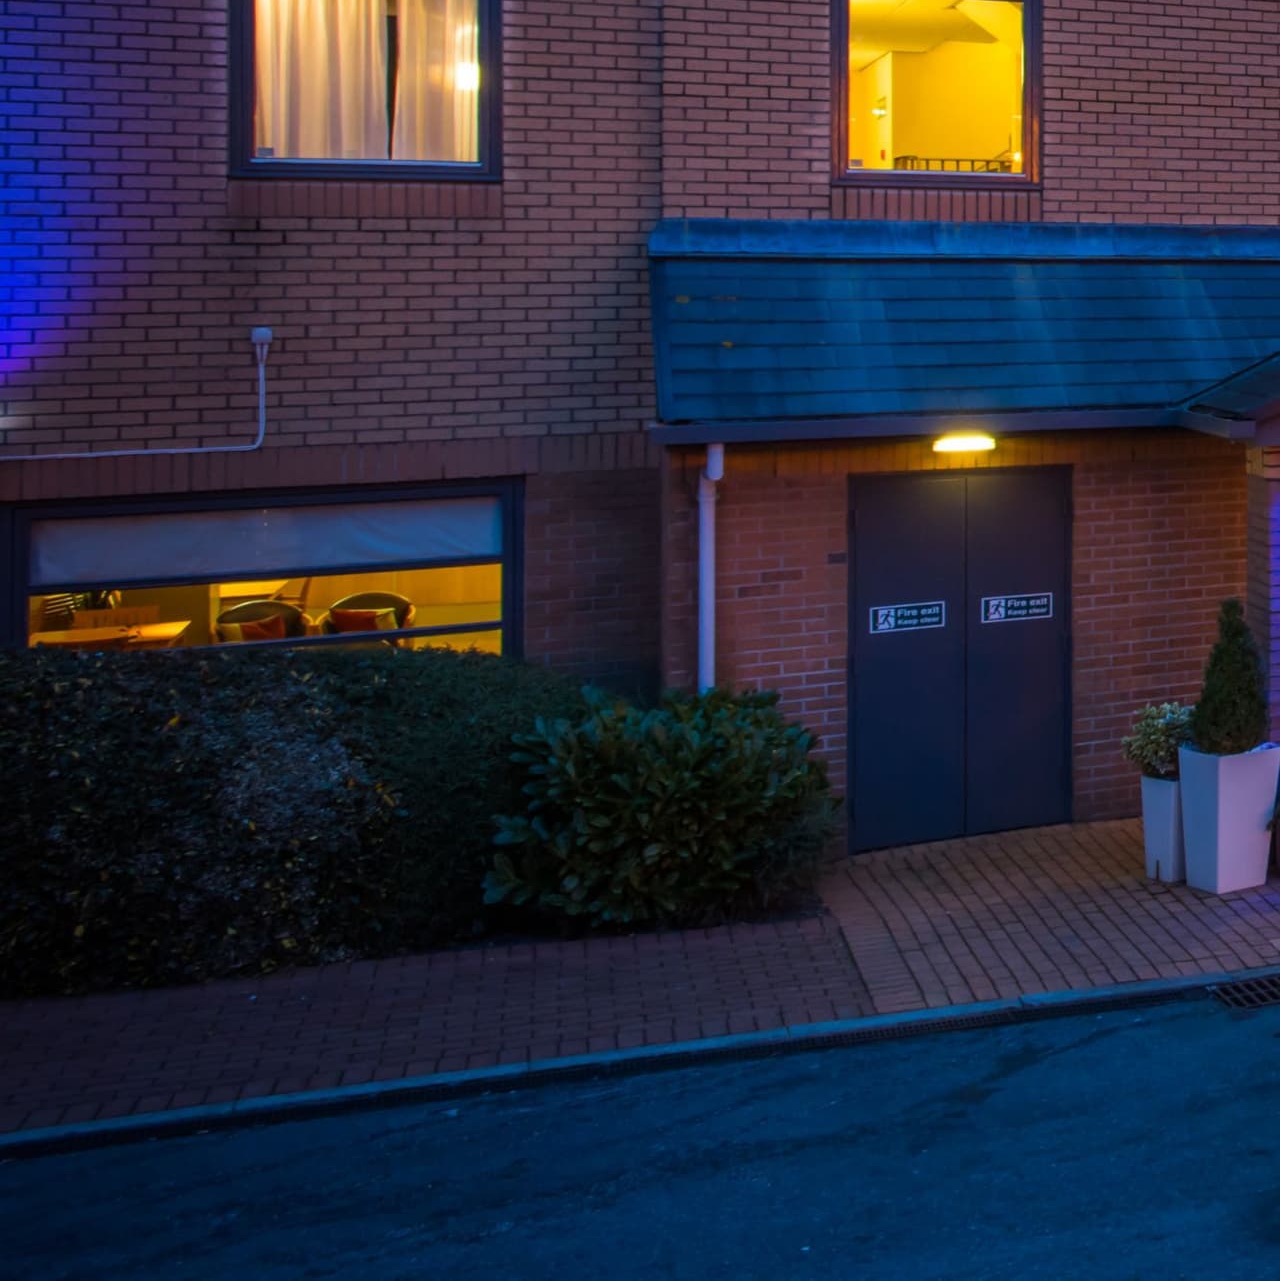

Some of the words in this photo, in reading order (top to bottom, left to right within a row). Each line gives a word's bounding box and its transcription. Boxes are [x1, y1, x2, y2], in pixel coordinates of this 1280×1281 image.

[1007, 599, 1026, 607] Fire
[1029, 598, 1047, 606] exit
[897, 608, 918, 617] Fire
[920, 606, 939, 615] exit
